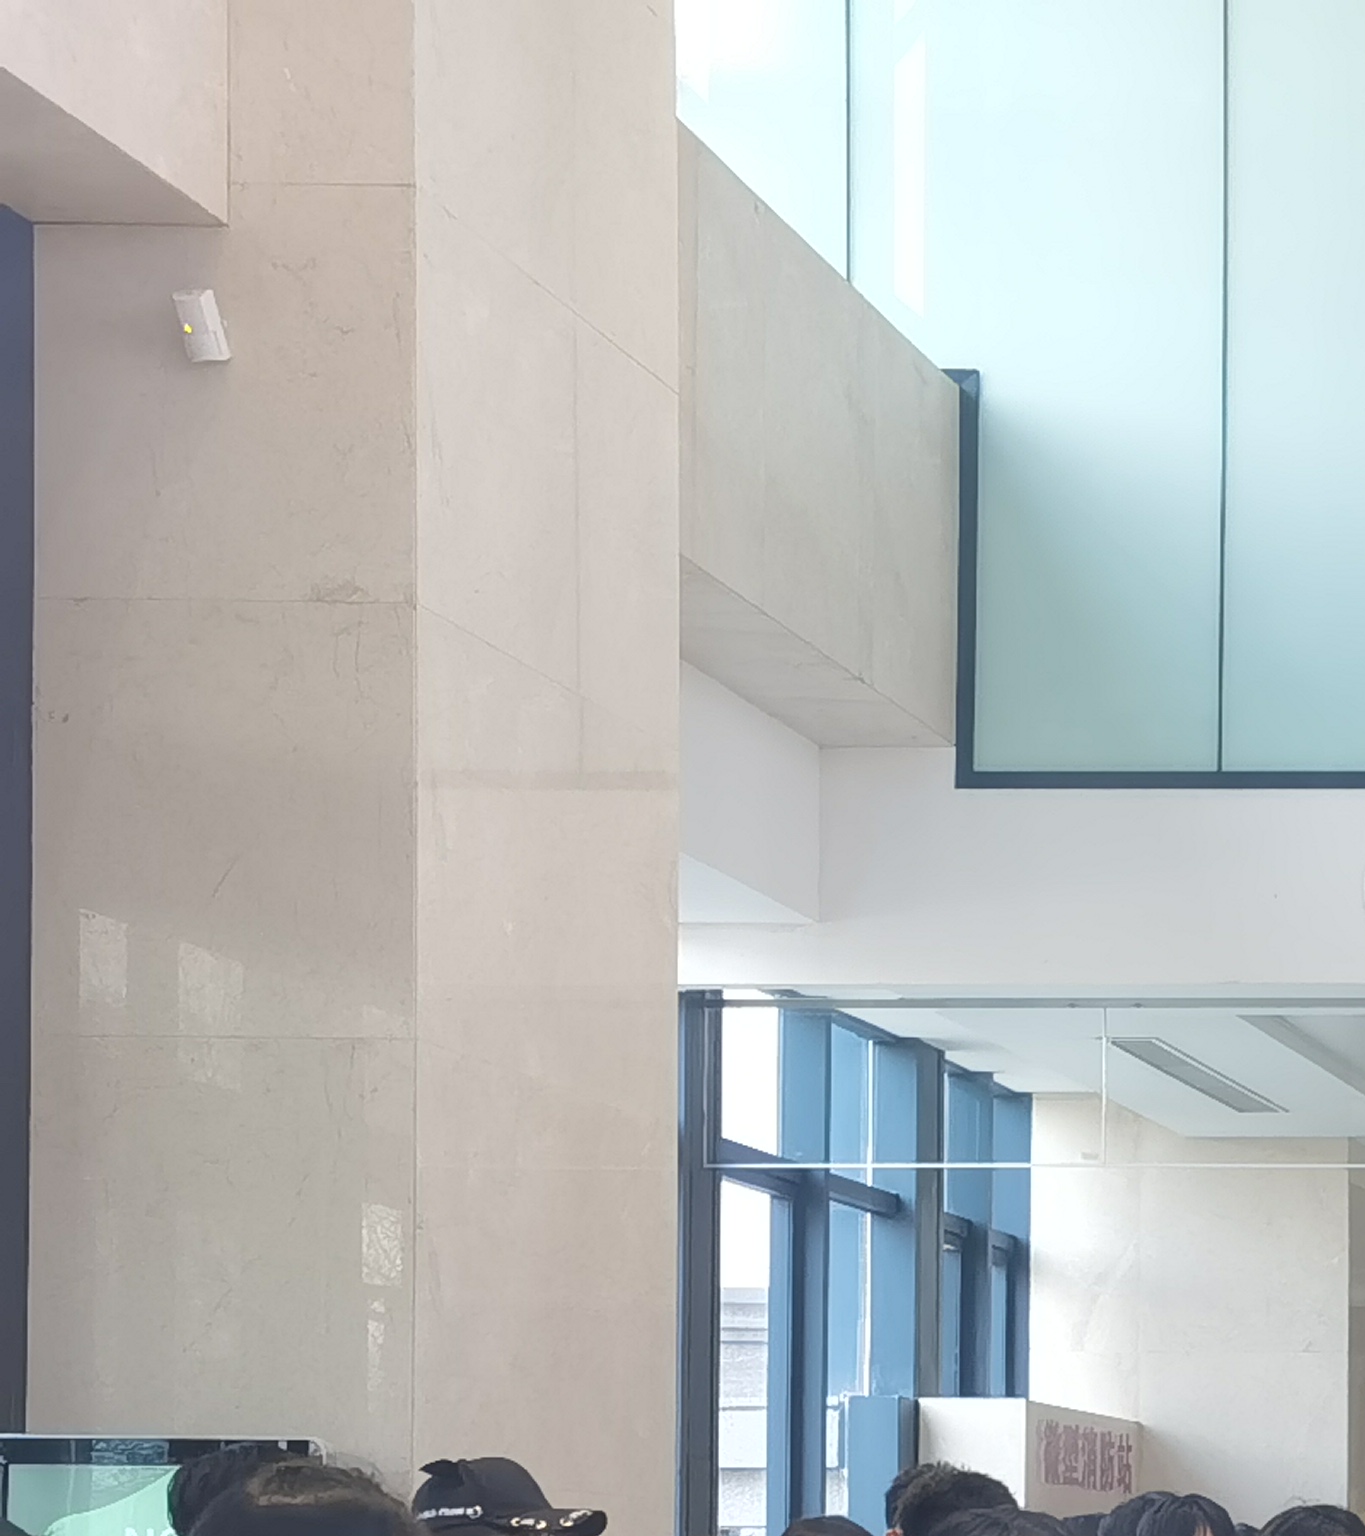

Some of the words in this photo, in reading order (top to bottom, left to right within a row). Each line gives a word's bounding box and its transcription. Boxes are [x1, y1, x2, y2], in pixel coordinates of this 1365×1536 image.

[1036, 1418, 1133, 1495] 微型消防站
